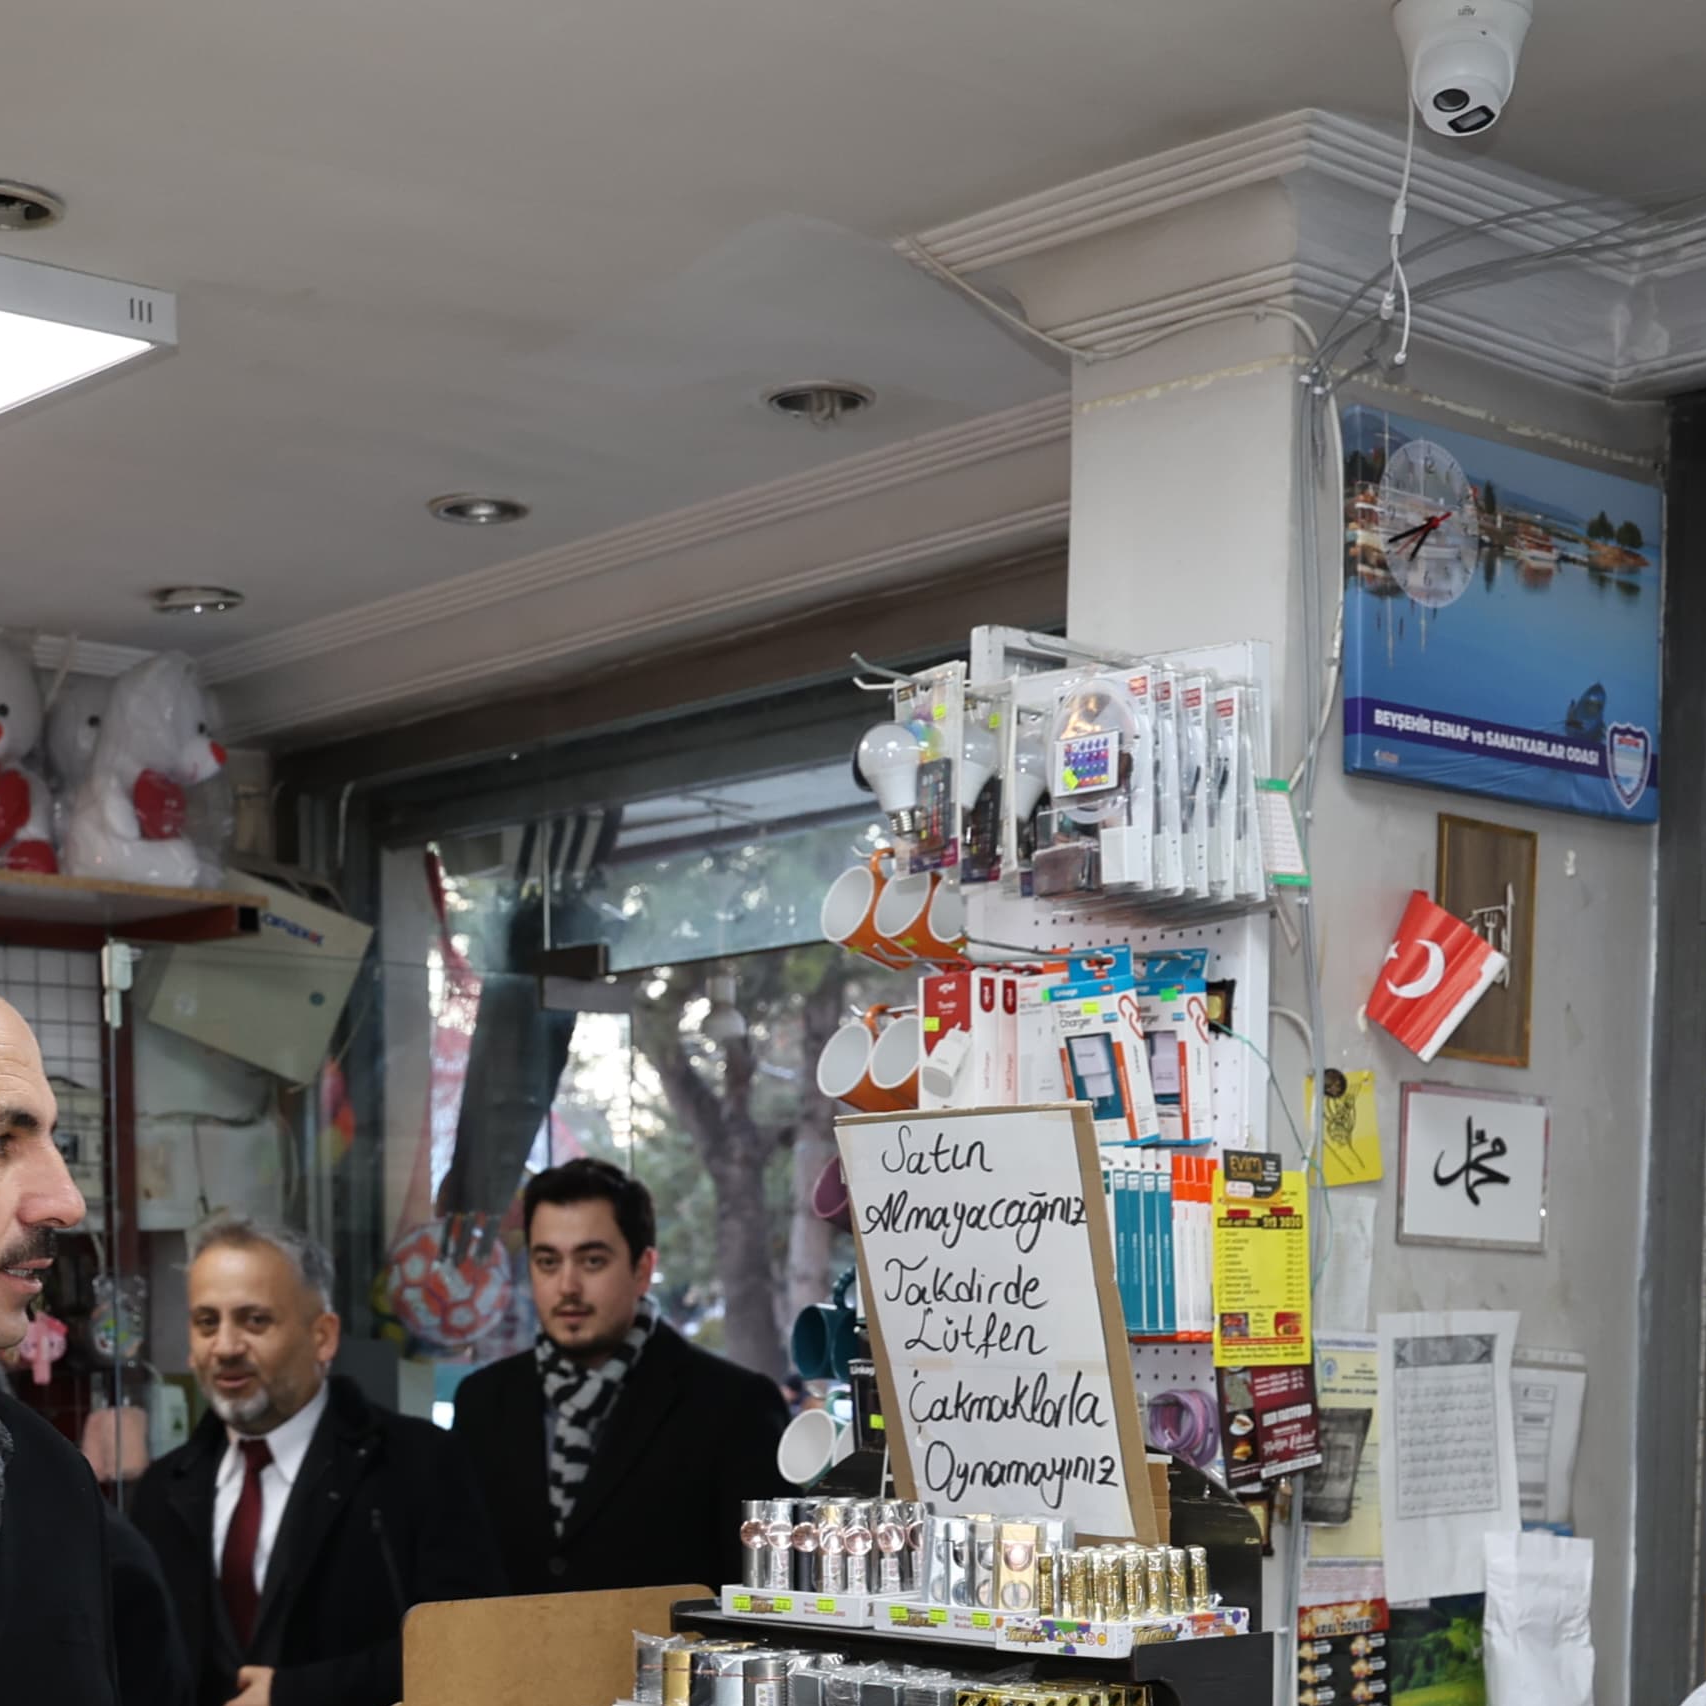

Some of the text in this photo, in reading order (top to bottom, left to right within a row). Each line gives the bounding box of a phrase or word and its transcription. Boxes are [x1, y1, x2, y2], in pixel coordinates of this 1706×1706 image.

[1374, 708, 1432, 736] BEYŞEHİR
[1432, 721, 1470, 744] ESNAF
[1471, 731, 1485, 746] ve
[1485, 730, 1566, 761] SANATKARLAR
[882, 1126, 993, 1175] Satın
[905, 1307, 1048, 1355] Lütfen
[925, 1438, 1119, 1508] Oynamayınız
